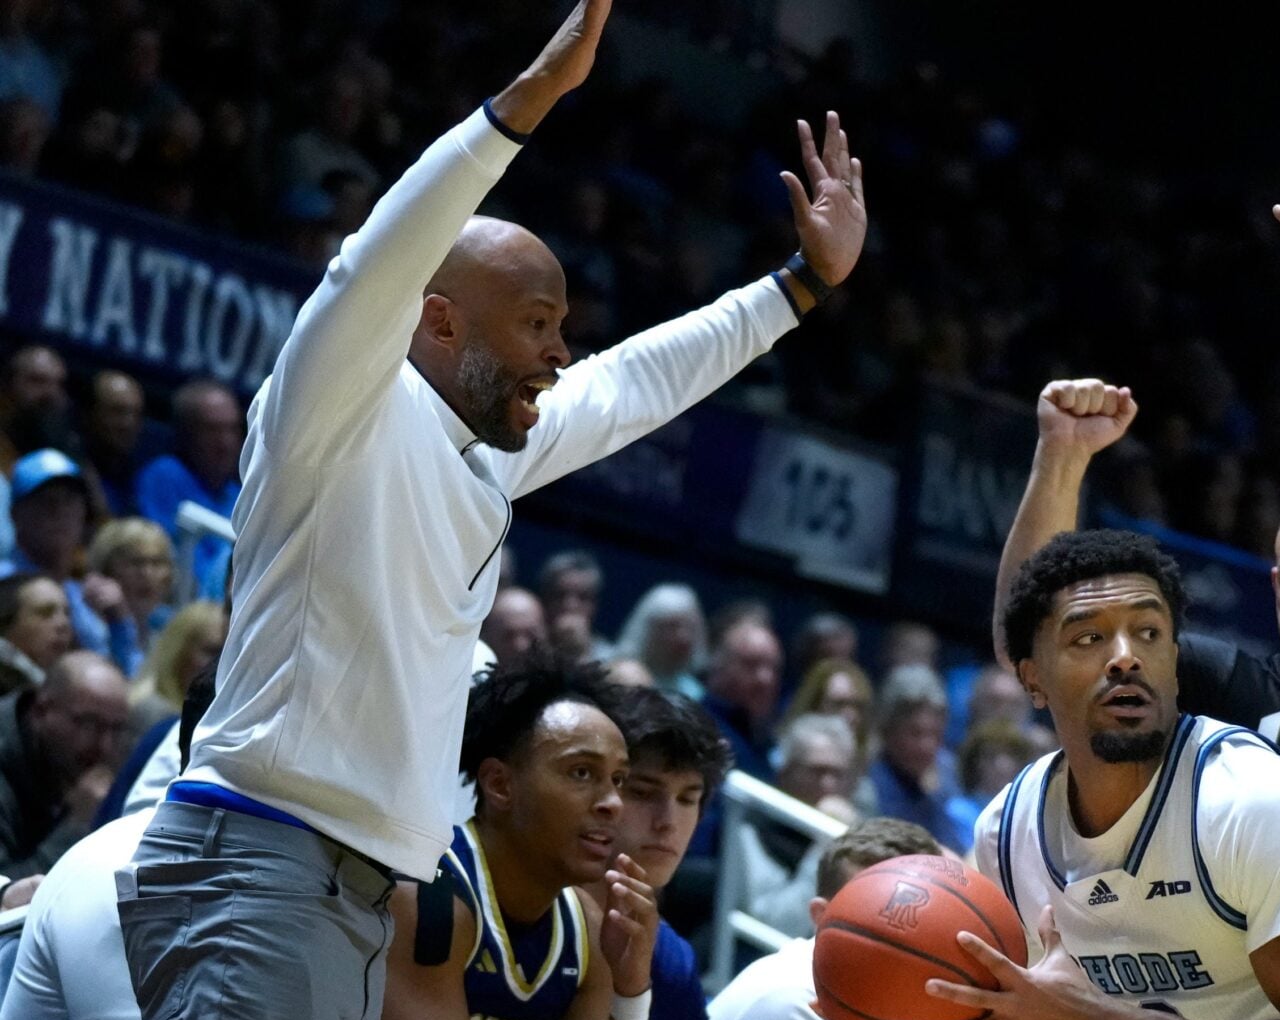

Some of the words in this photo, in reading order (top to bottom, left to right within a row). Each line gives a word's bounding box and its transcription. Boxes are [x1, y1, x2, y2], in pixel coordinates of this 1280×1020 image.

[43, 214, 298, 393] NATION
[1088, 893, 1119, 906] adidas
[1145, 880, 1192, 900] A10
[1070, 950, 1215, 994] HODE
